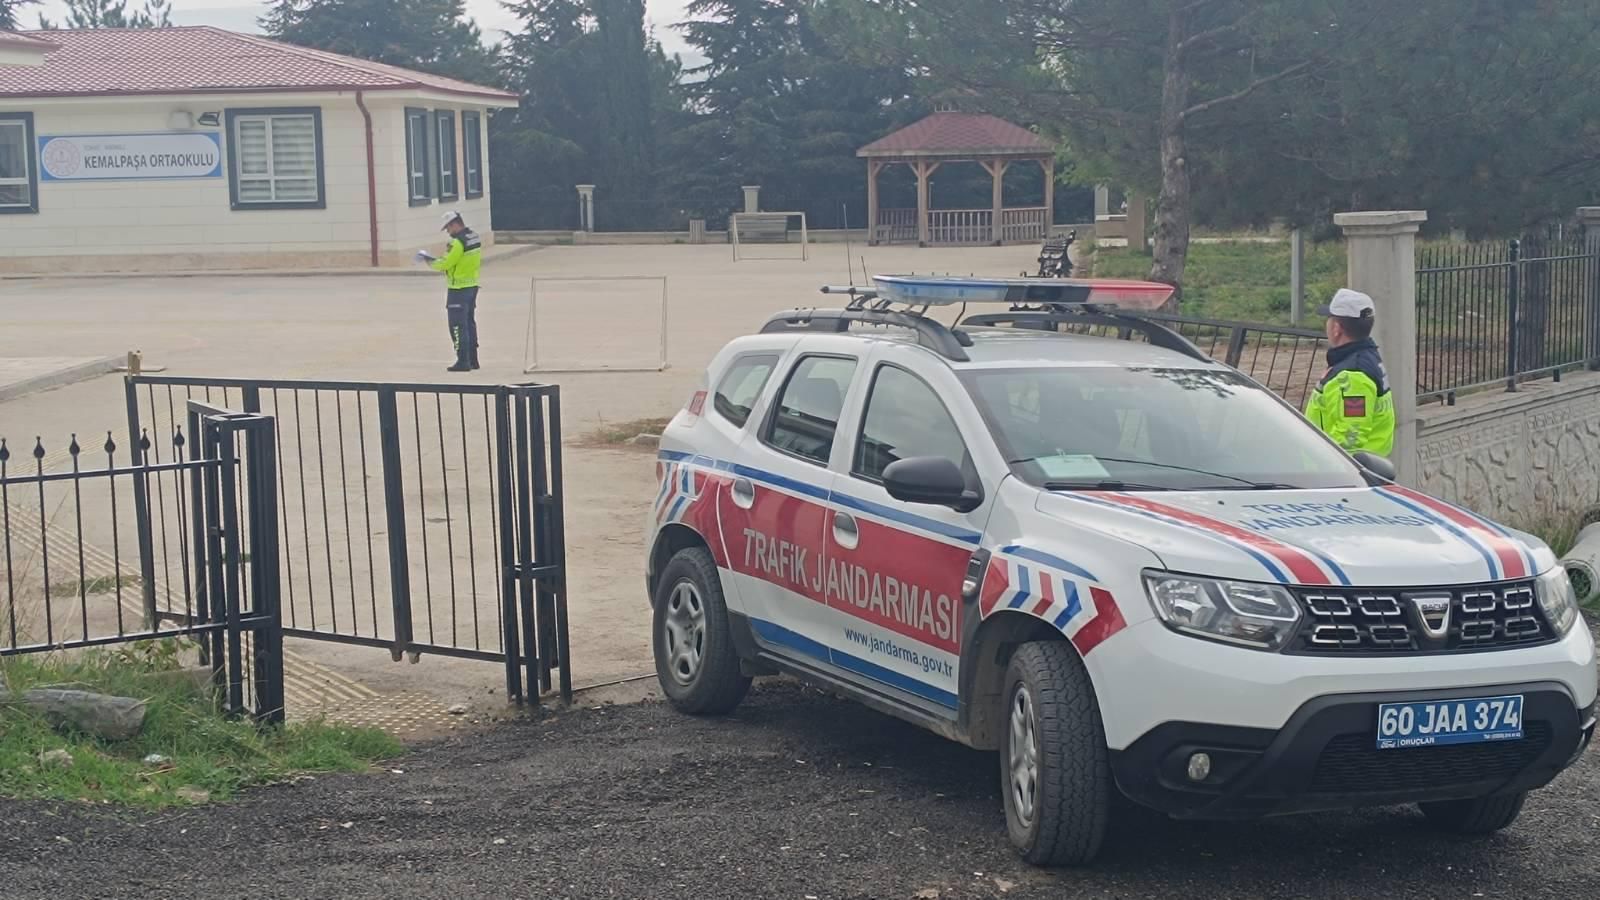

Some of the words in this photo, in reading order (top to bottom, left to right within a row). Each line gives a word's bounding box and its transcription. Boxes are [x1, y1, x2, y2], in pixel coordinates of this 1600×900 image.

[84, 154, 147, 171] KEMALPAŞA
[149, 153, 213, 168] ORTAOKULU
[1238, 515, 1435, 531] JANDARMASI
[812, 554, 958, 643] JANDARMASI
[844, 627, 953, 678] www.jandarma.gov.tr
[1382, 706, 1414, 736] 60
[1418, 703, 1468, 734] JAA
[1474, 700, 1519, 730] 374
